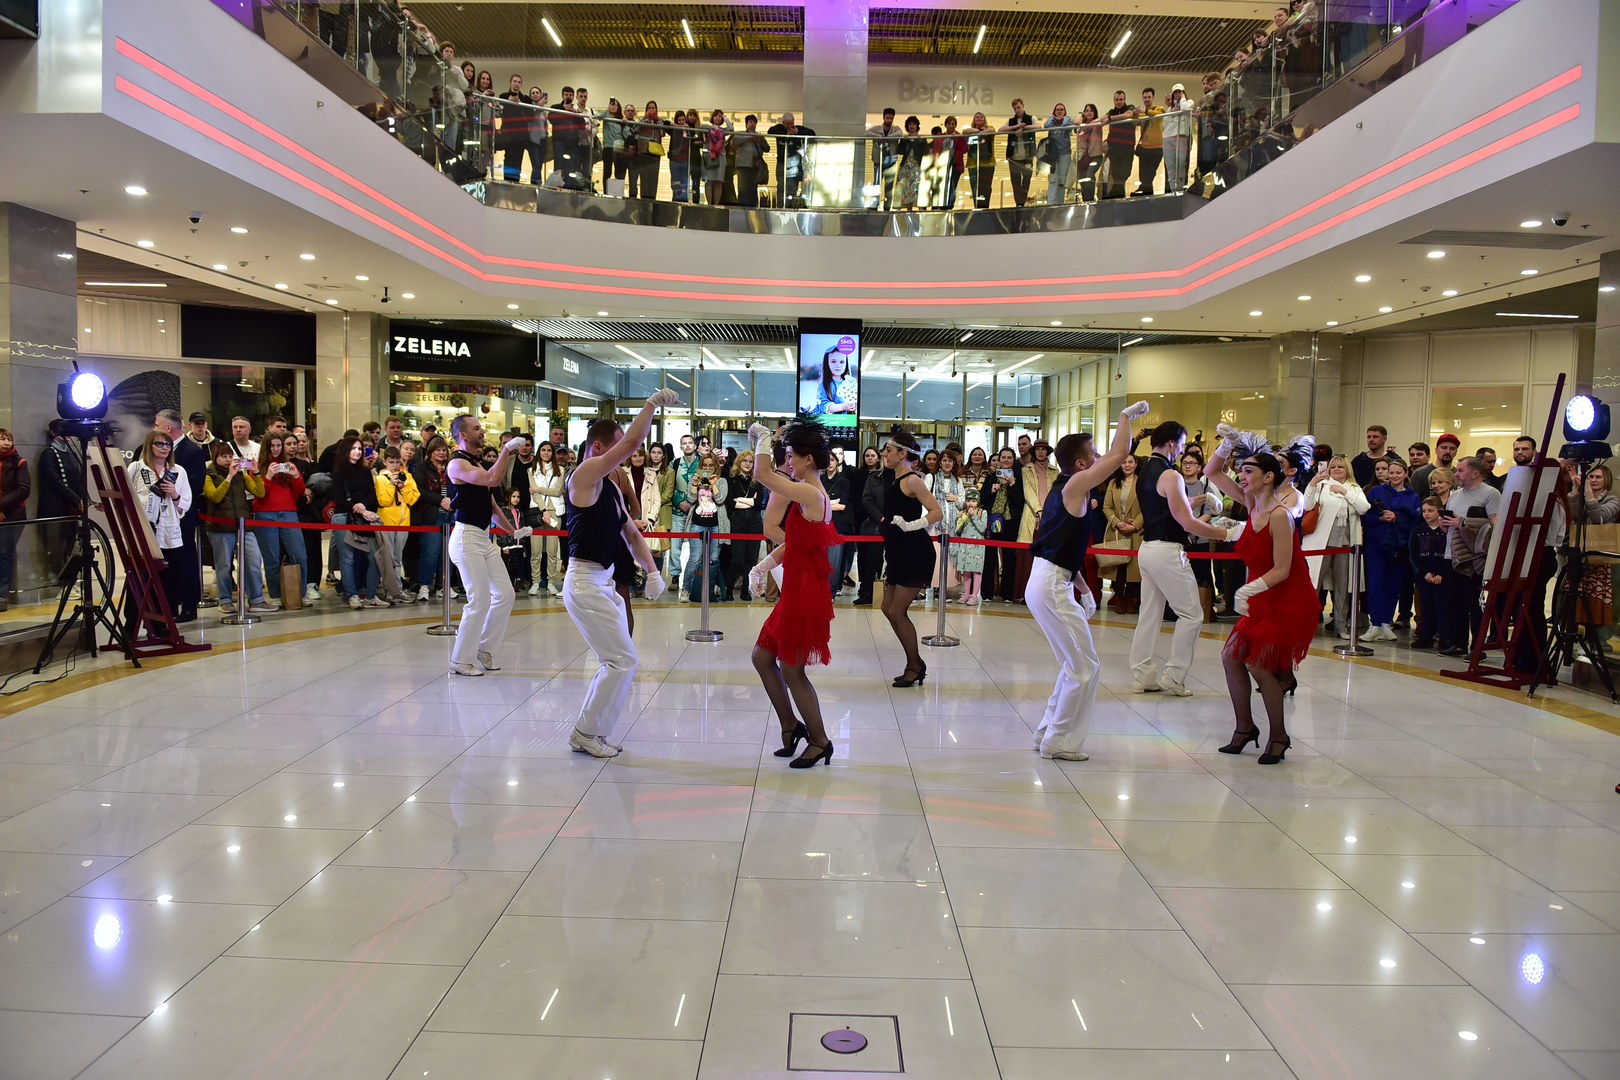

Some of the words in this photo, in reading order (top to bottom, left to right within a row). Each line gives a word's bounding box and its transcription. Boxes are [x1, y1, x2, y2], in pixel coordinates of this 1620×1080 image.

[898, 79, 993, 106] Bershka
[394, 336, 471, 357] ZELENA
[563, 357, 579, 375] ZELENA
